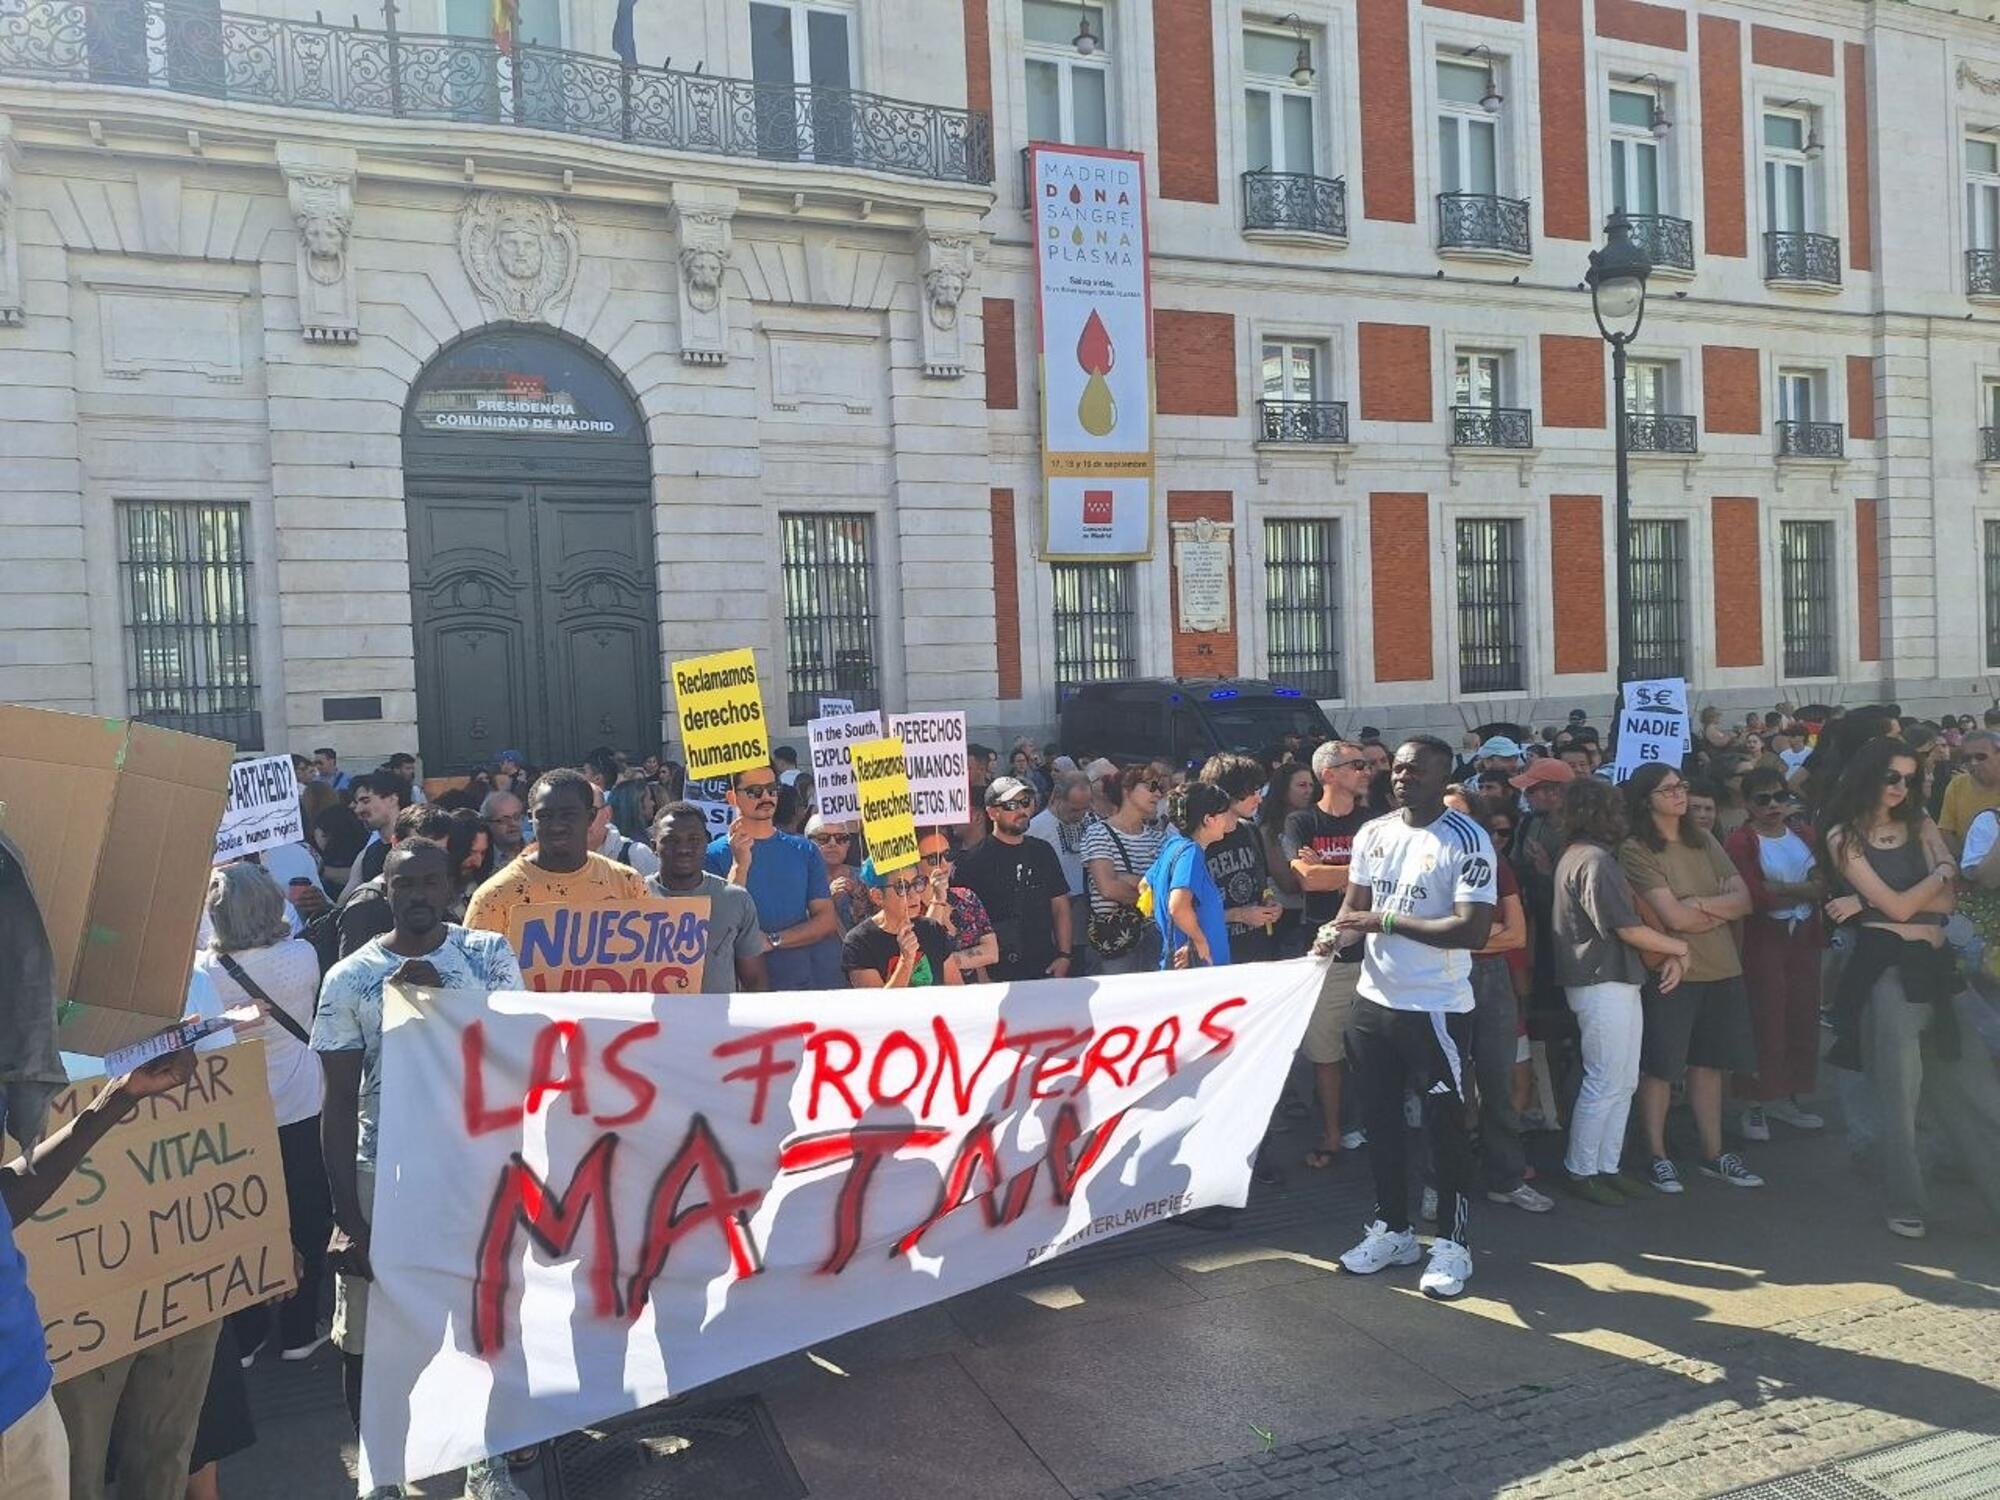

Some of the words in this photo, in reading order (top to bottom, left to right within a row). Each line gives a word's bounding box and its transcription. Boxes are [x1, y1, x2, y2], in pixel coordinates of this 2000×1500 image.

[1044, 162, 1130, 186] MADRID
[1047, 203, 1134, 229] SANGRE,
[1049, 245, 1133, 267] PLASMA
[477, 400, 576, 415] PRESIDENCIA
[436, 413, 529, 430] COMUNIDAD
[533, 418, 554, 430] DE
[556, 419, 615, 432] MADRID
[677, 664, 756, 696] Reclamamos
[684, 698, 760, 732] derechos
[1626, 718, 1681, 737] NADIE
[813, 728, 823, 742] In
[825, 725, 843, 741] the
[845, 720, 879, 738] South,
[688, 737, 766, 768] humanos.
[814, 745, 851, 768] EXPLO
[1640, 743, 1660, 760] ES
[818, 773, 828, 788] In
[830, 770, 847, 786] the
[905, 753, 965, 780] UMANOS!
[822, 792, 861, 815] EXPUL
[863, 790, 911, 823] derechos
[951, 788, 967, 812] NO!
[867, 832, 918, 863] humanos.
[1467, 857, 1490, 888] hp
[519, 909, 709, 969] NUESTRAS
[460, 1018, 661, 1137] LAS
[712, 997, 1248, 1125] FRONTERAS
[125, 1121, 256, 1186] VITAL.
[56, 1218, 131, 1276] TU
[148, 1173, 269, 1255] MURO
[472, 1101, 1127, 1358] MATAN
[134, 1245, 287, 1342] LETAL
